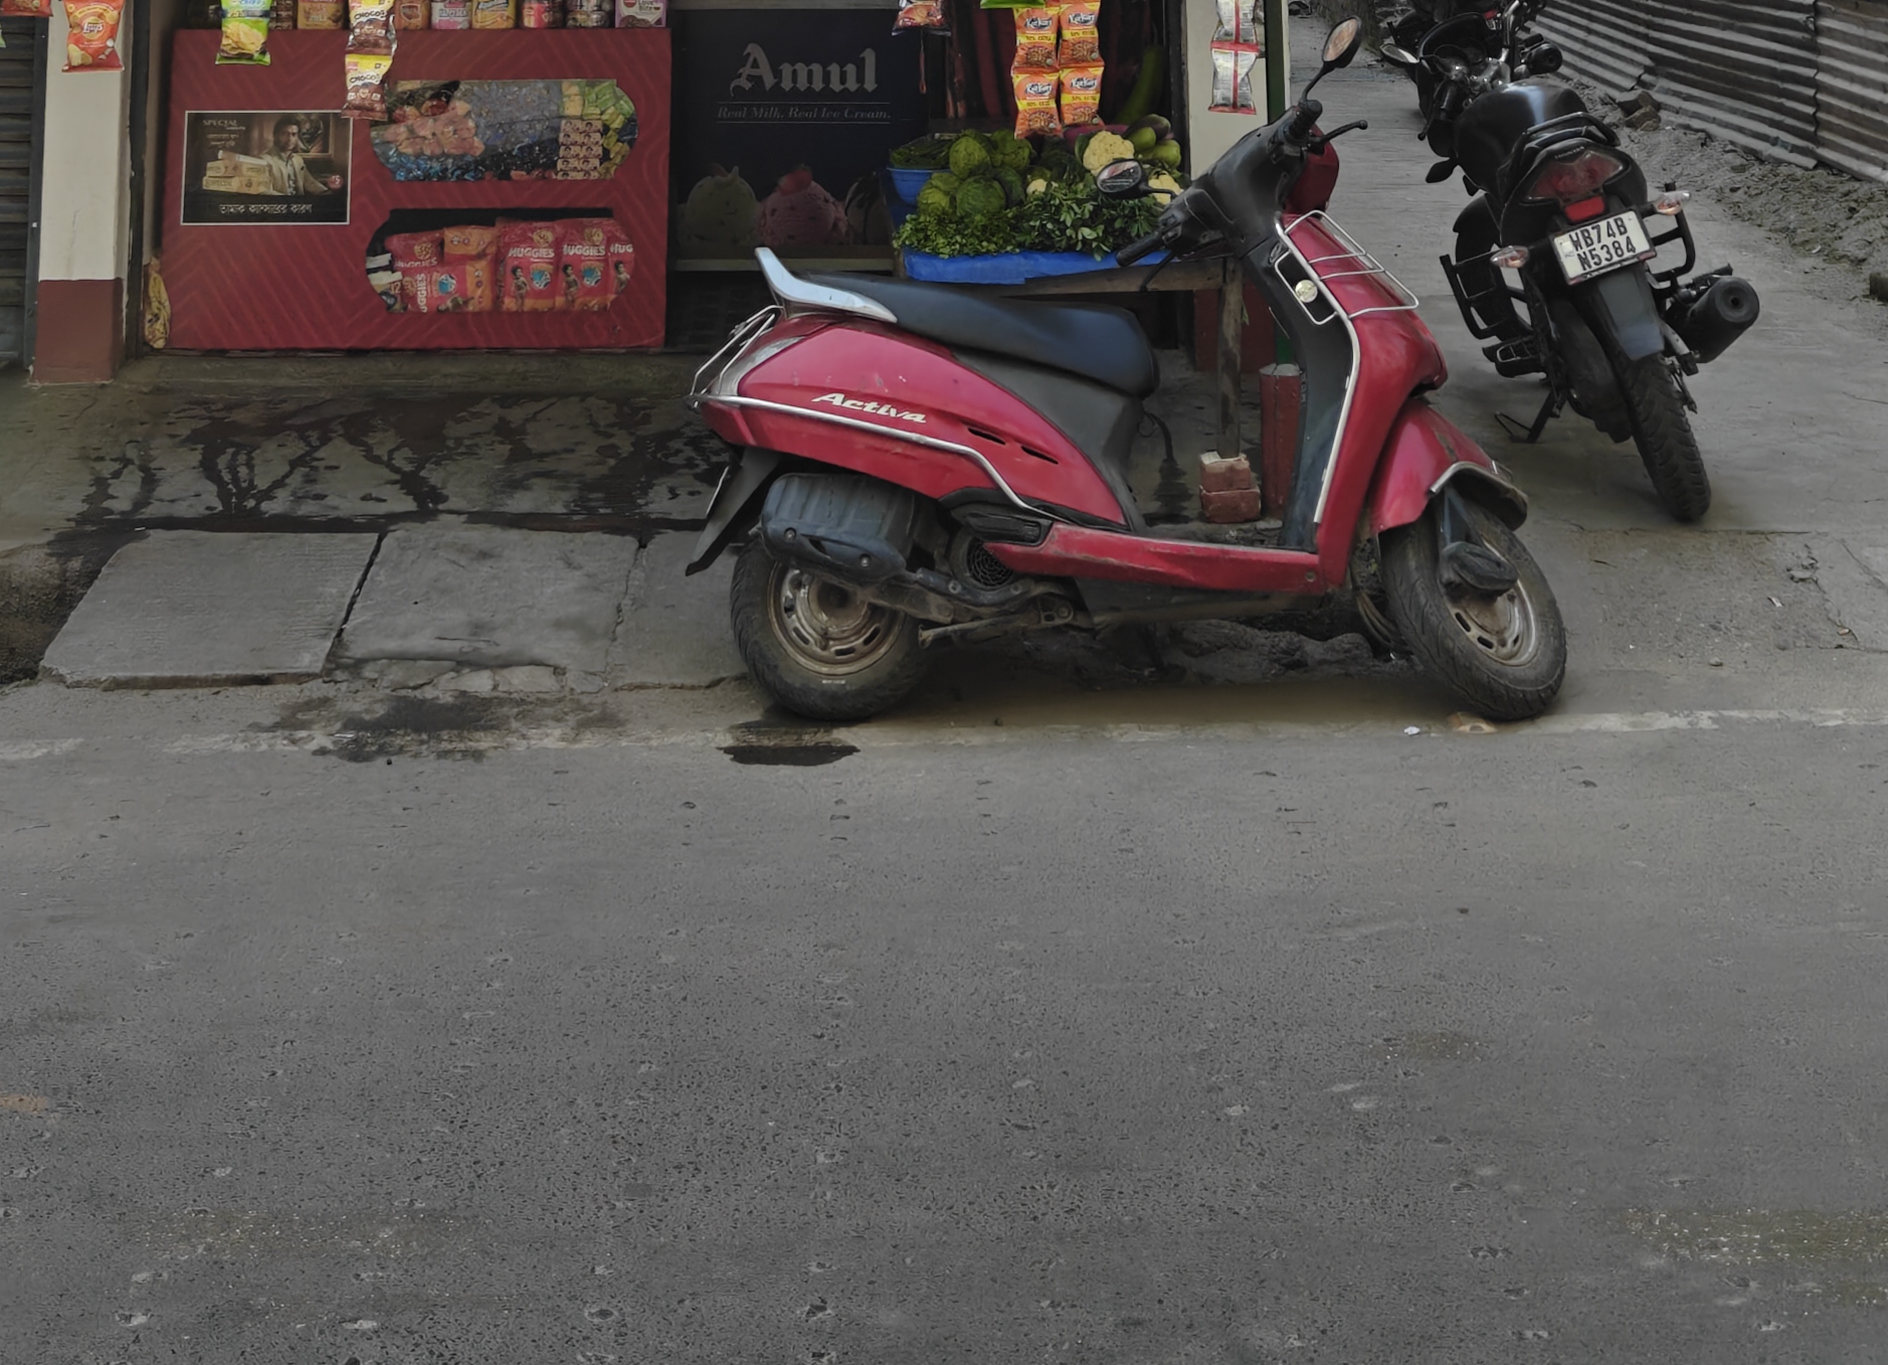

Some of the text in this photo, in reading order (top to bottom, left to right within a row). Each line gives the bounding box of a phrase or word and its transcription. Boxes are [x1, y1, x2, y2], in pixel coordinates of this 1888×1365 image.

[730, 43, 879, 97] Amul
[717, 106, 747, 119] Real
[788, 106, 817, 119] Real
[1569, 217, 1628, 251] WB74B
[509, 247, 555, 259] HUGGIES
[1577, 236, 1636, 271] N5384
[417, 272, 428, 313] UGGIES
[811, 392, 927, 423] Activa
